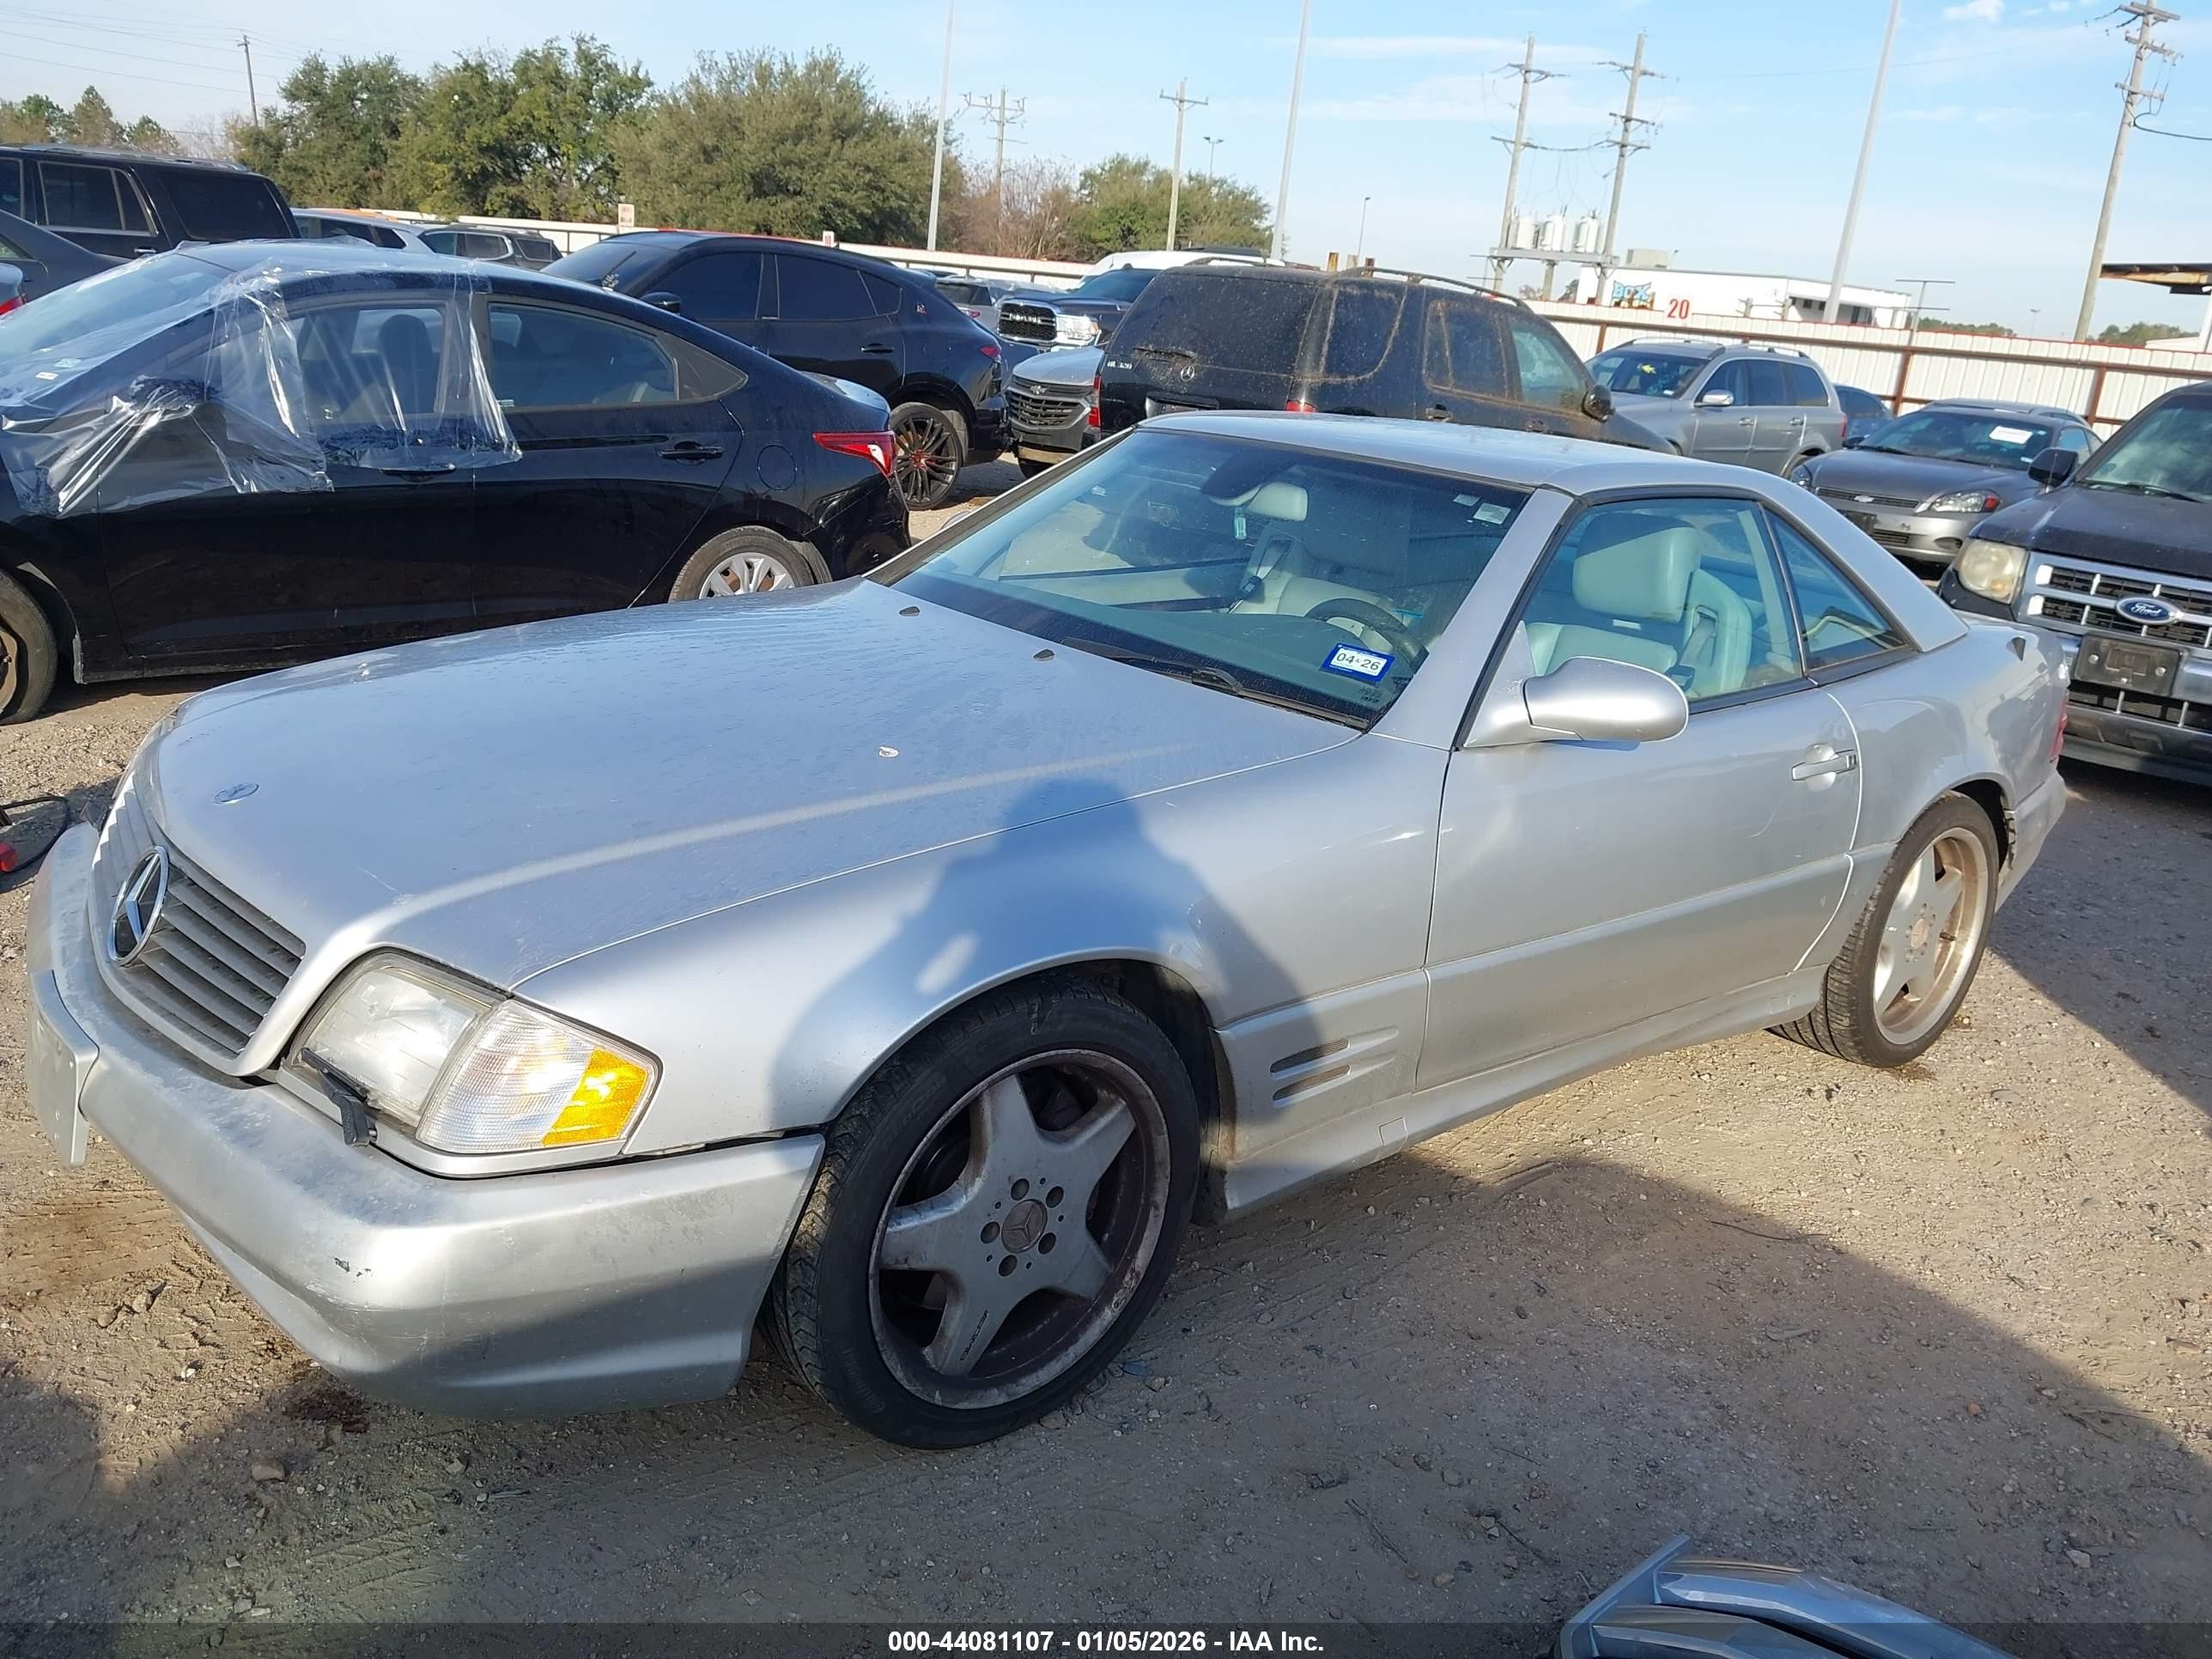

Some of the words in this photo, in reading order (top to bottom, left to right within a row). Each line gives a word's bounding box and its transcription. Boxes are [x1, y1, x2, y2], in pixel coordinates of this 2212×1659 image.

[1612, 280, 1651, 302] BOX
[1668, 299, 1689, 319] 20
[2130, 603, 2161, 617] Ford
[1336, 653, 1355, 664] 04
[1360, 659, 1381, 671] 26
